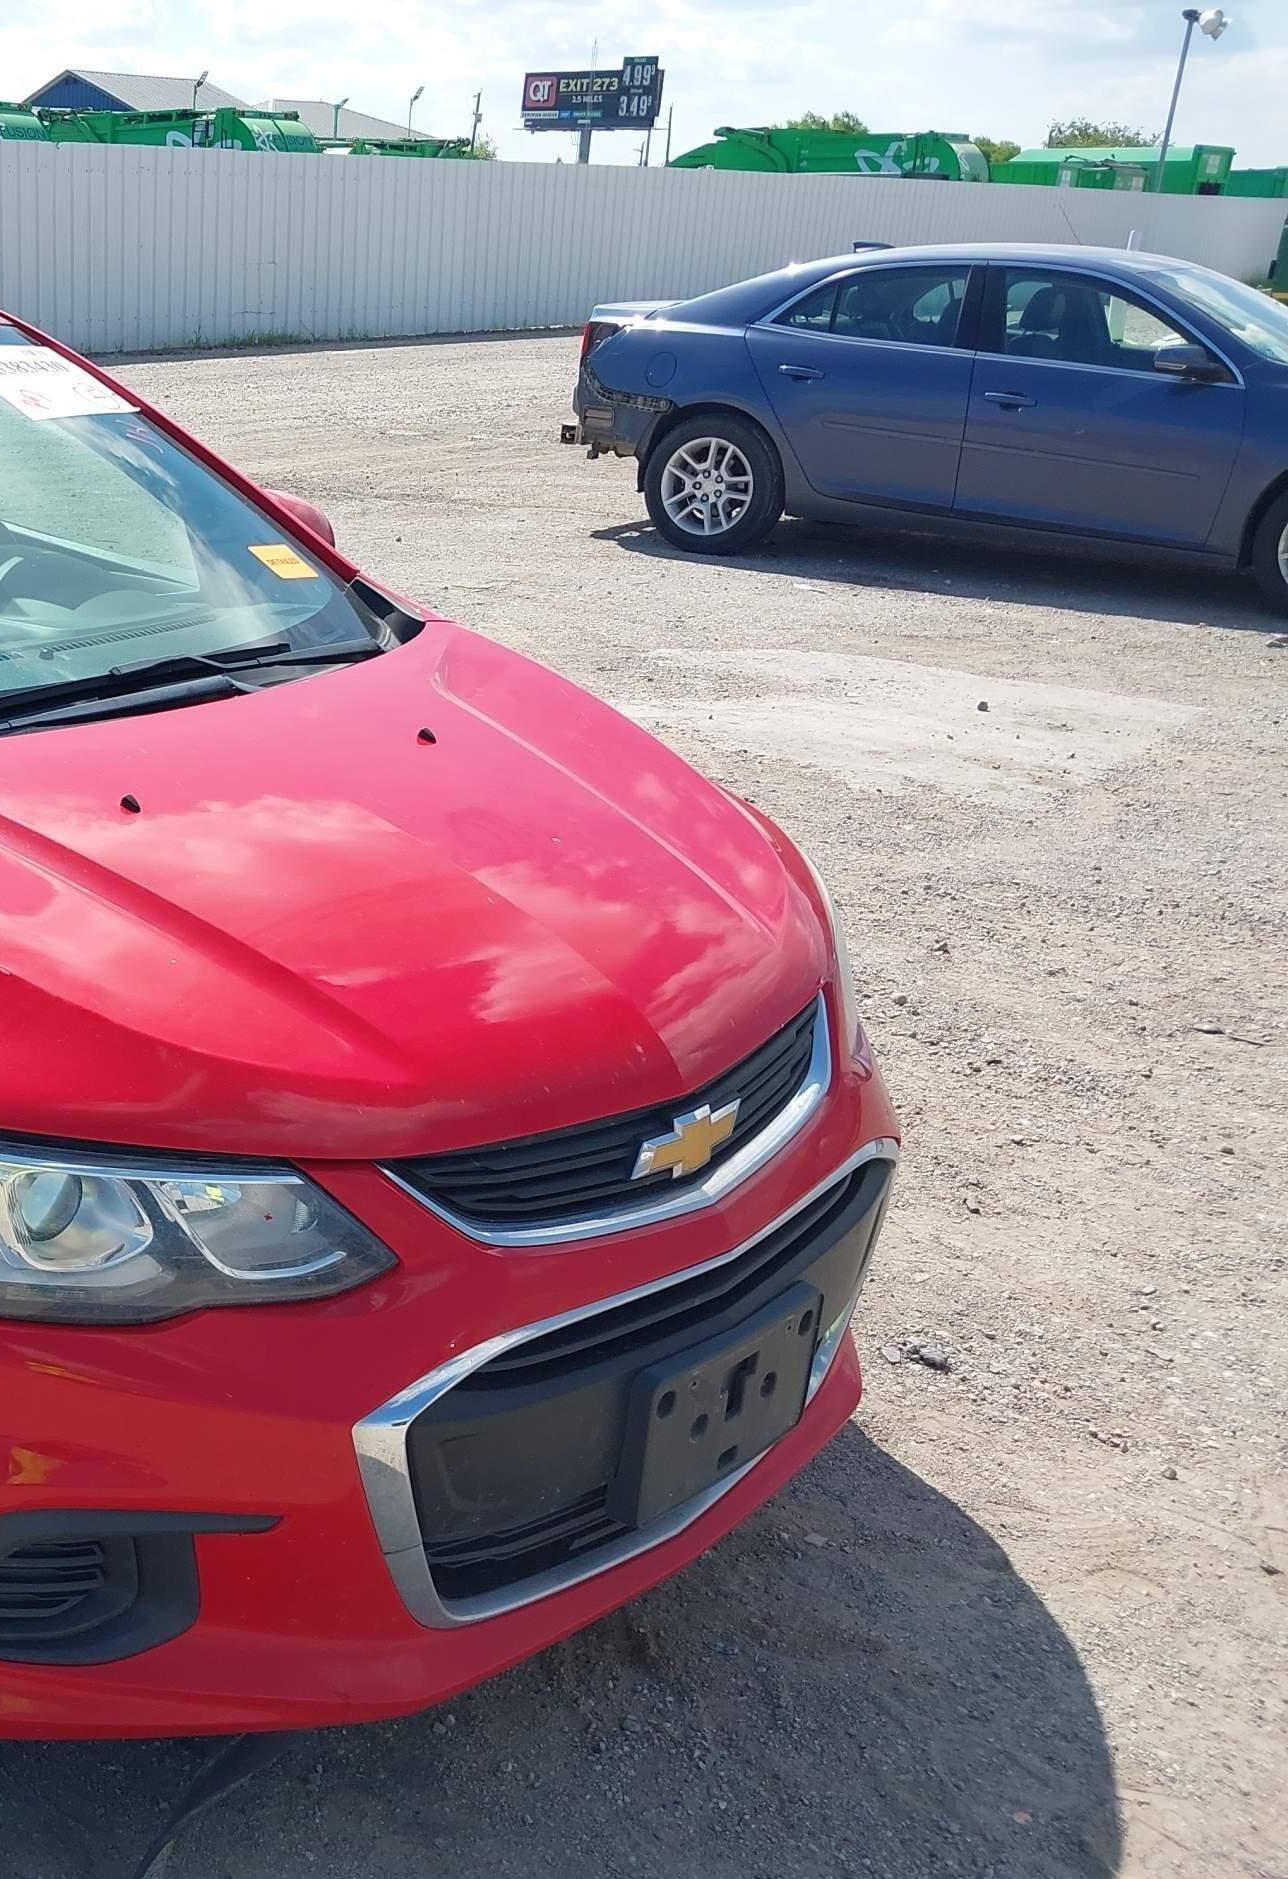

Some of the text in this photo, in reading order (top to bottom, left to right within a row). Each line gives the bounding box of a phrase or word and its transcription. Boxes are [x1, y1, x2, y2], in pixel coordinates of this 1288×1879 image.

[529, 80, 553, 103] QT
[559, 77, 619, 92] EXIT 273
